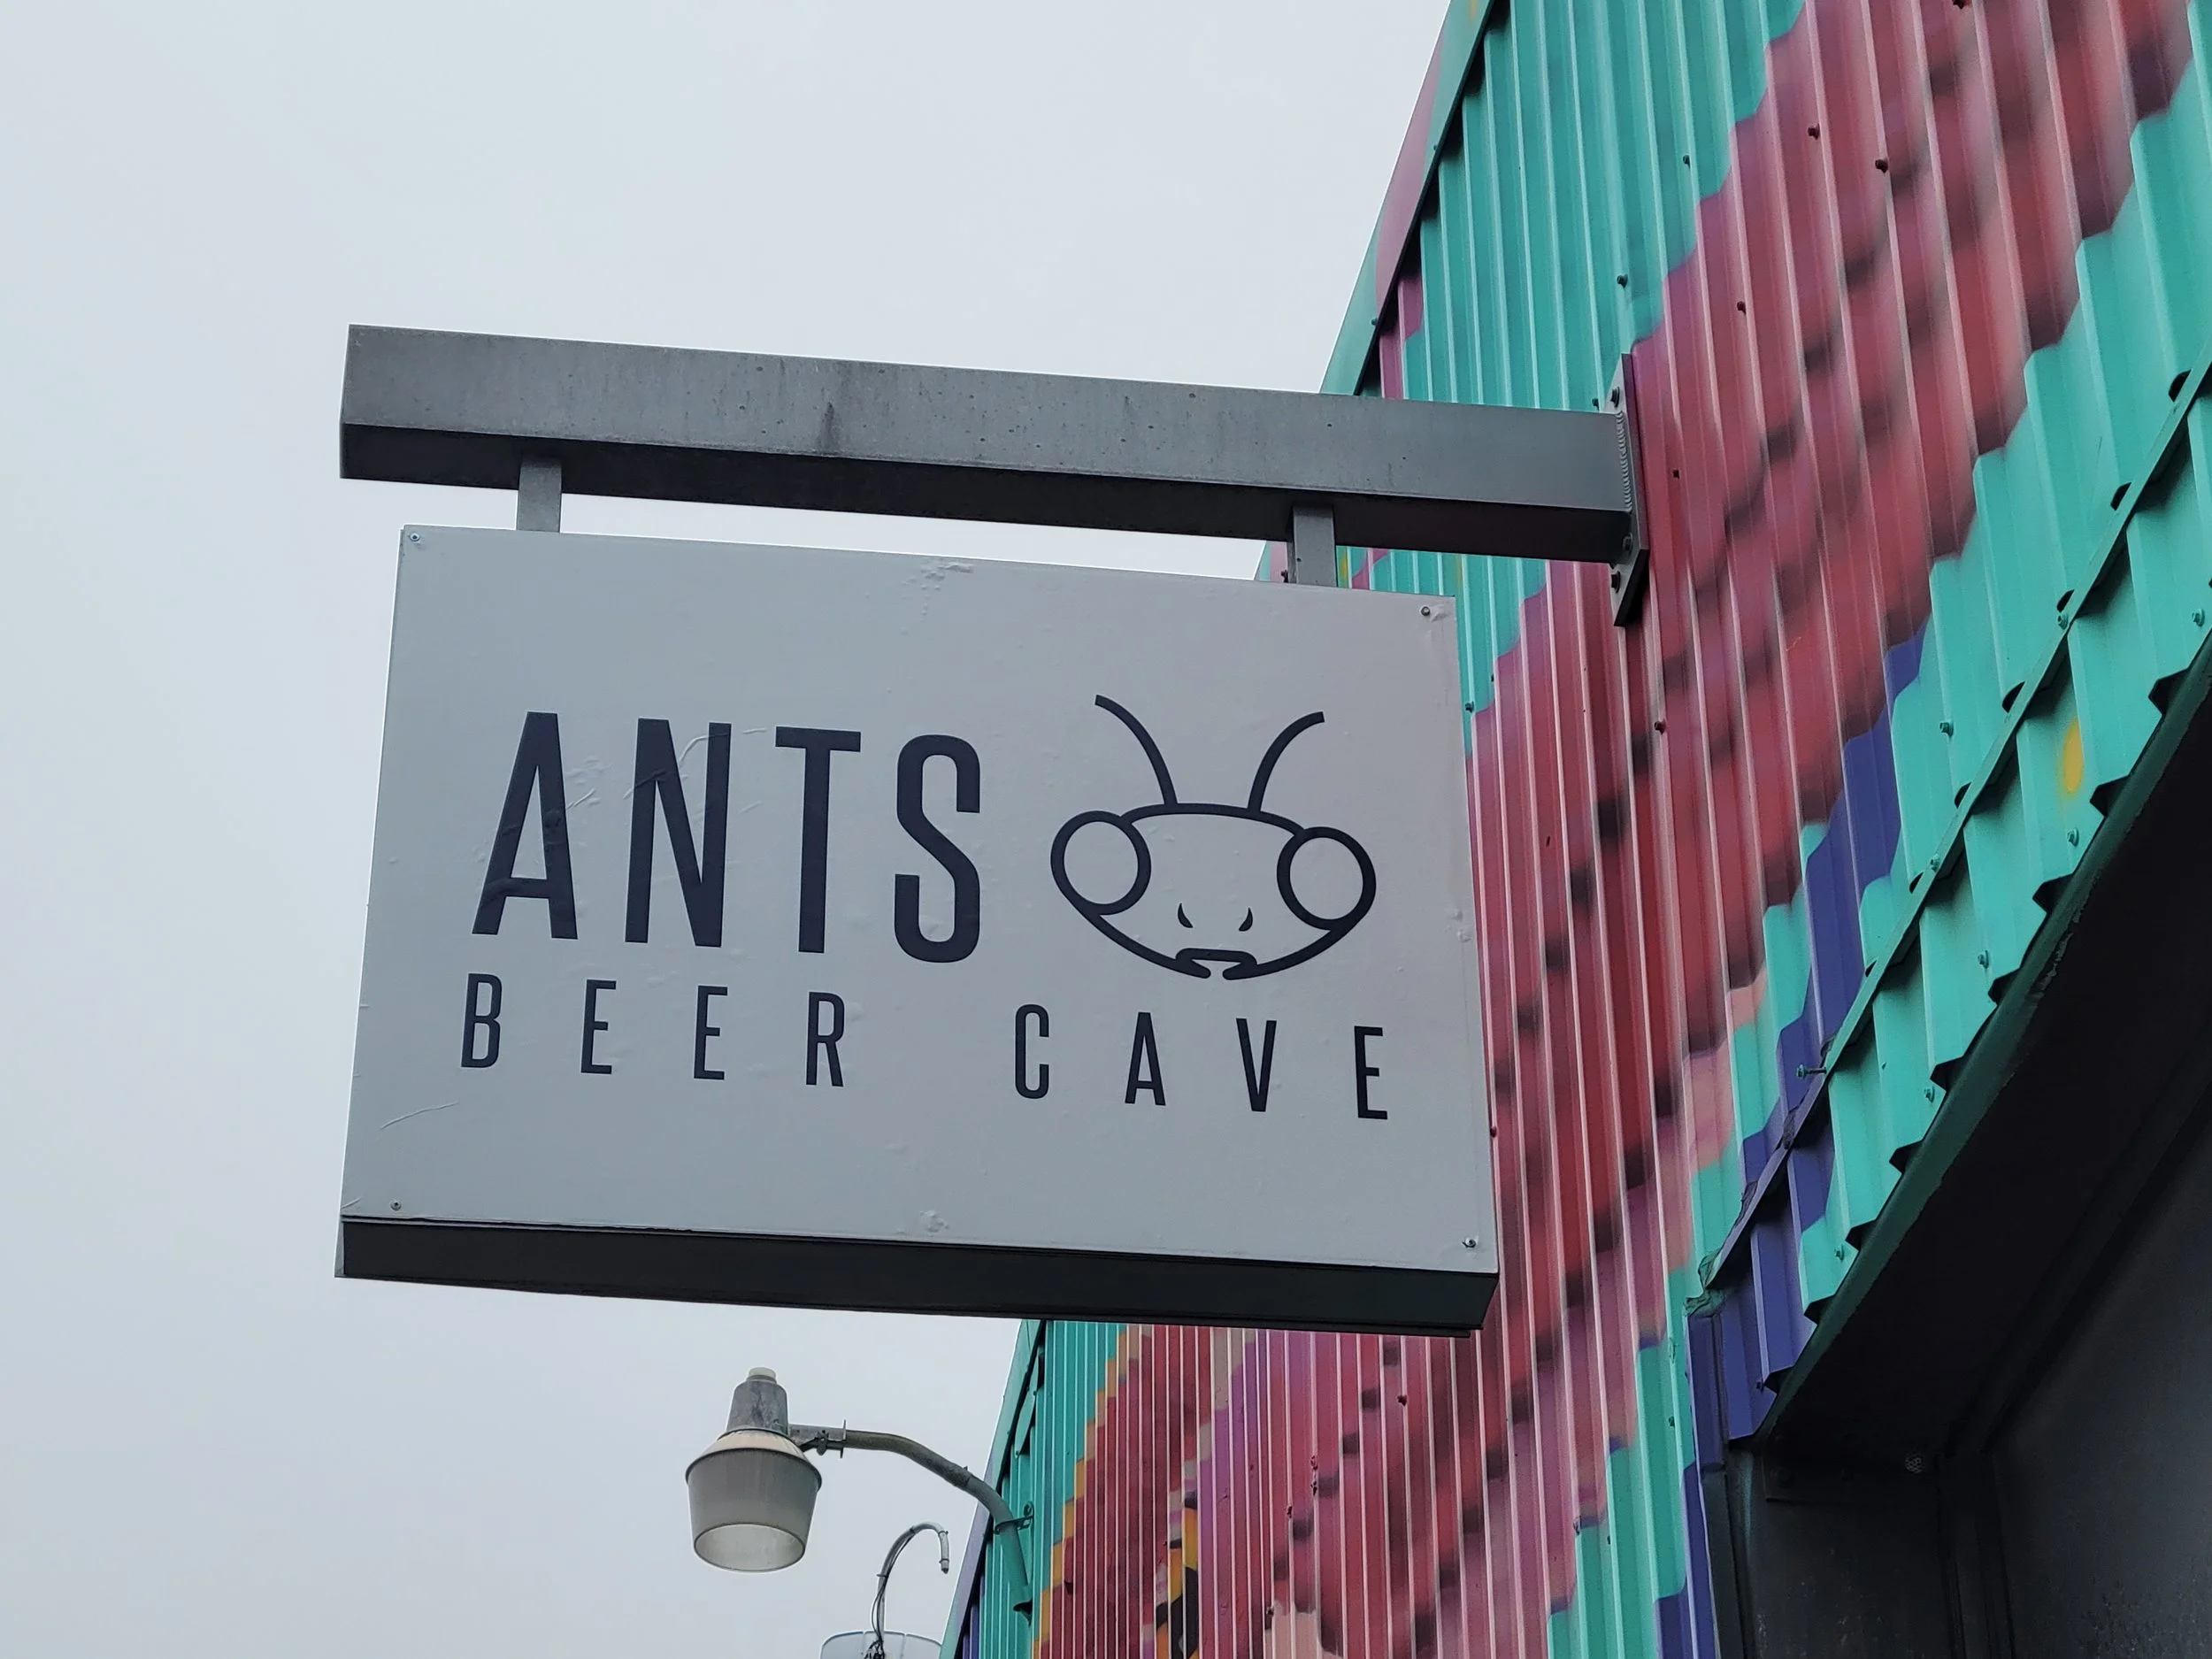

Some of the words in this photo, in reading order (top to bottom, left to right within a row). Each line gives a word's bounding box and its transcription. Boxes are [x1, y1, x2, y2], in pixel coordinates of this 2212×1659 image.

[471, 710, 982, 964] ANTS
[460, 972, 846, 1088] BEER
[1014, 1002, 1389, 1121] CAVE
